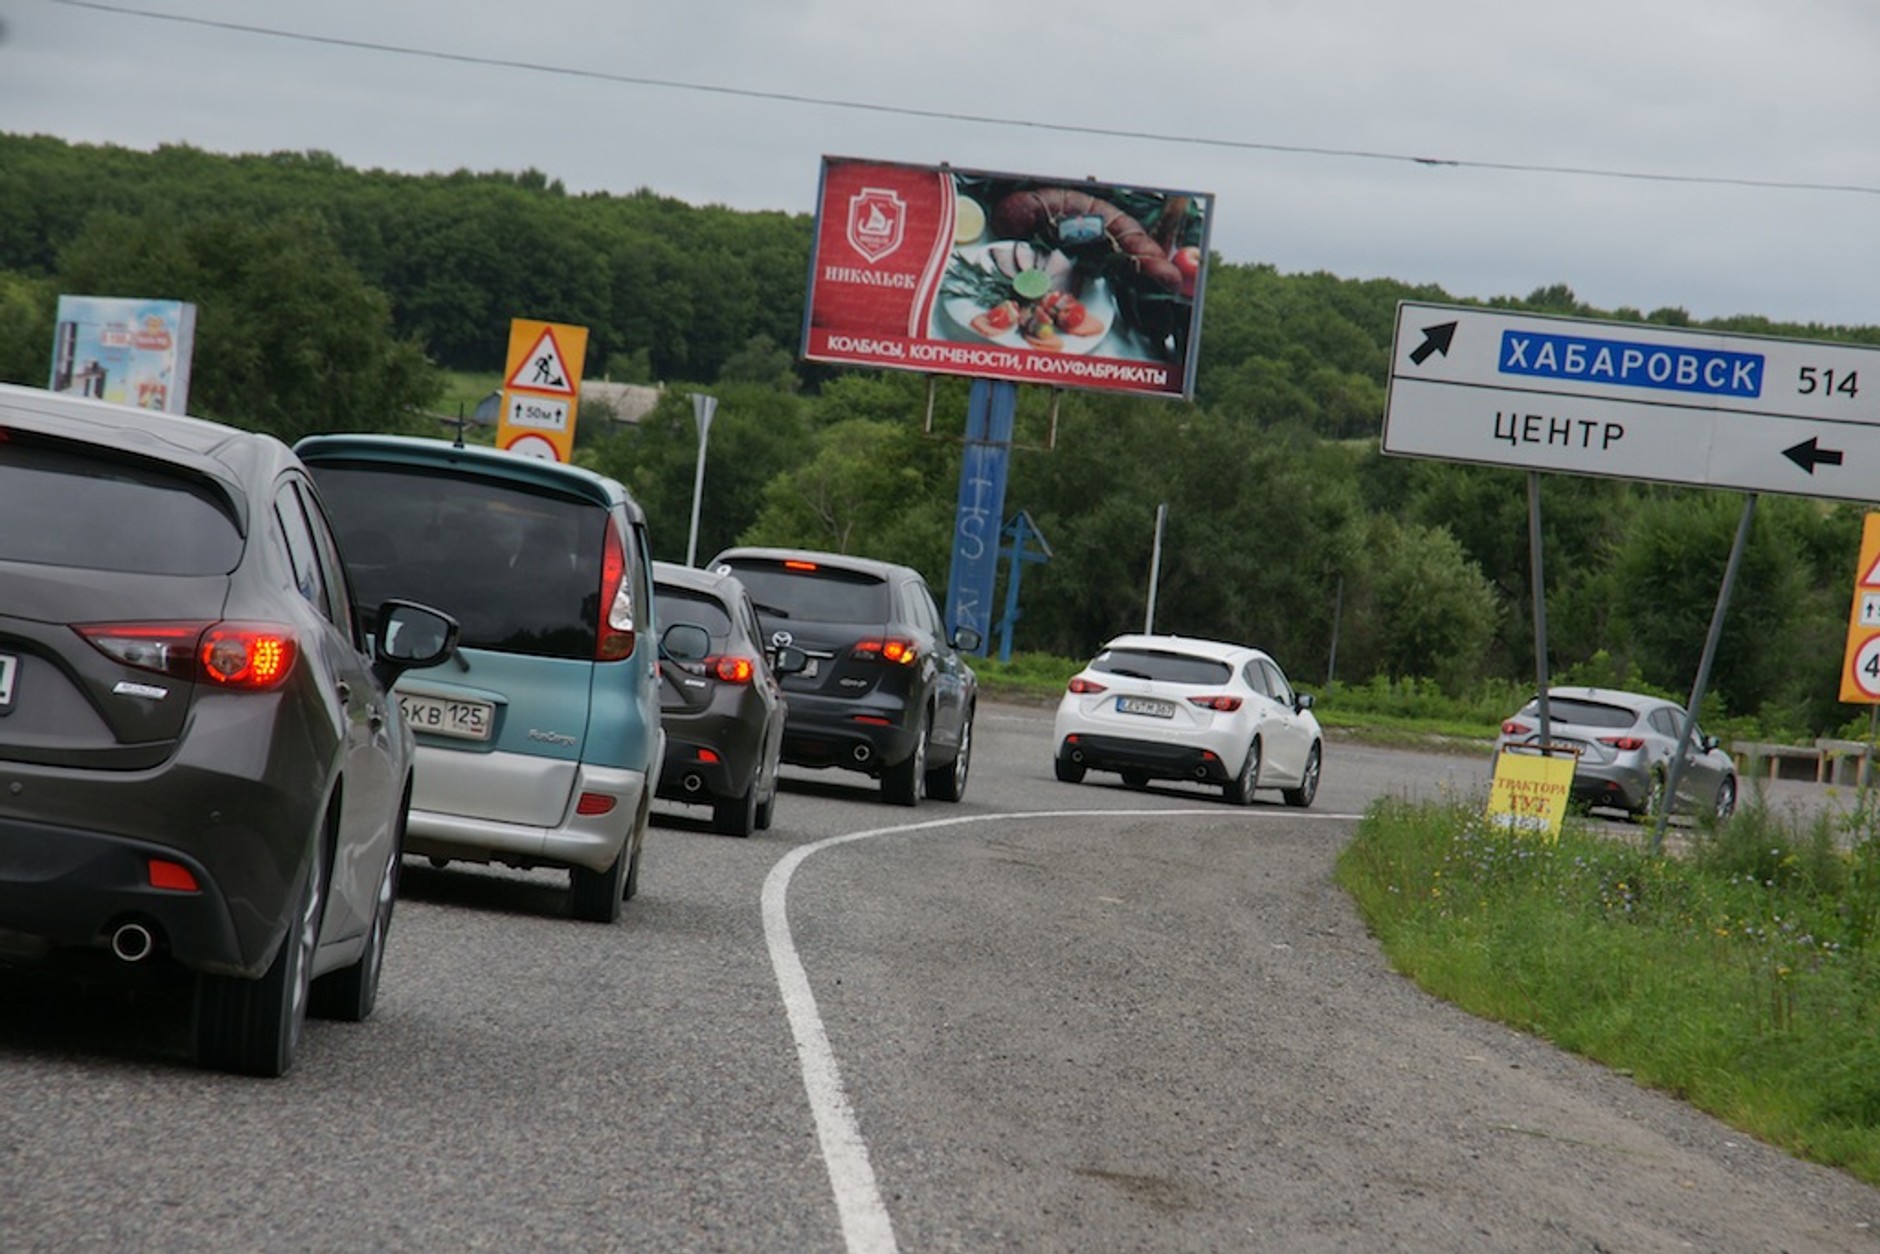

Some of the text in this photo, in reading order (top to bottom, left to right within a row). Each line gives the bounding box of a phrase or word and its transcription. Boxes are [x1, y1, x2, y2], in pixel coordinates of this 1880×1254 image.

[825, 265, 916, 290] НИКОЛЬСК
[827, 335, 1168, 385] КОЛБАСЫ, КОПЧЕНОСТИ, ПОЛУФАБРИКАТЫ
[1506, 337, 1858, 398] ХАБАРОВСК 514
[1493, 411, 1625, 450] ЦЕНТР
[448, 704, 483, 726] 125
